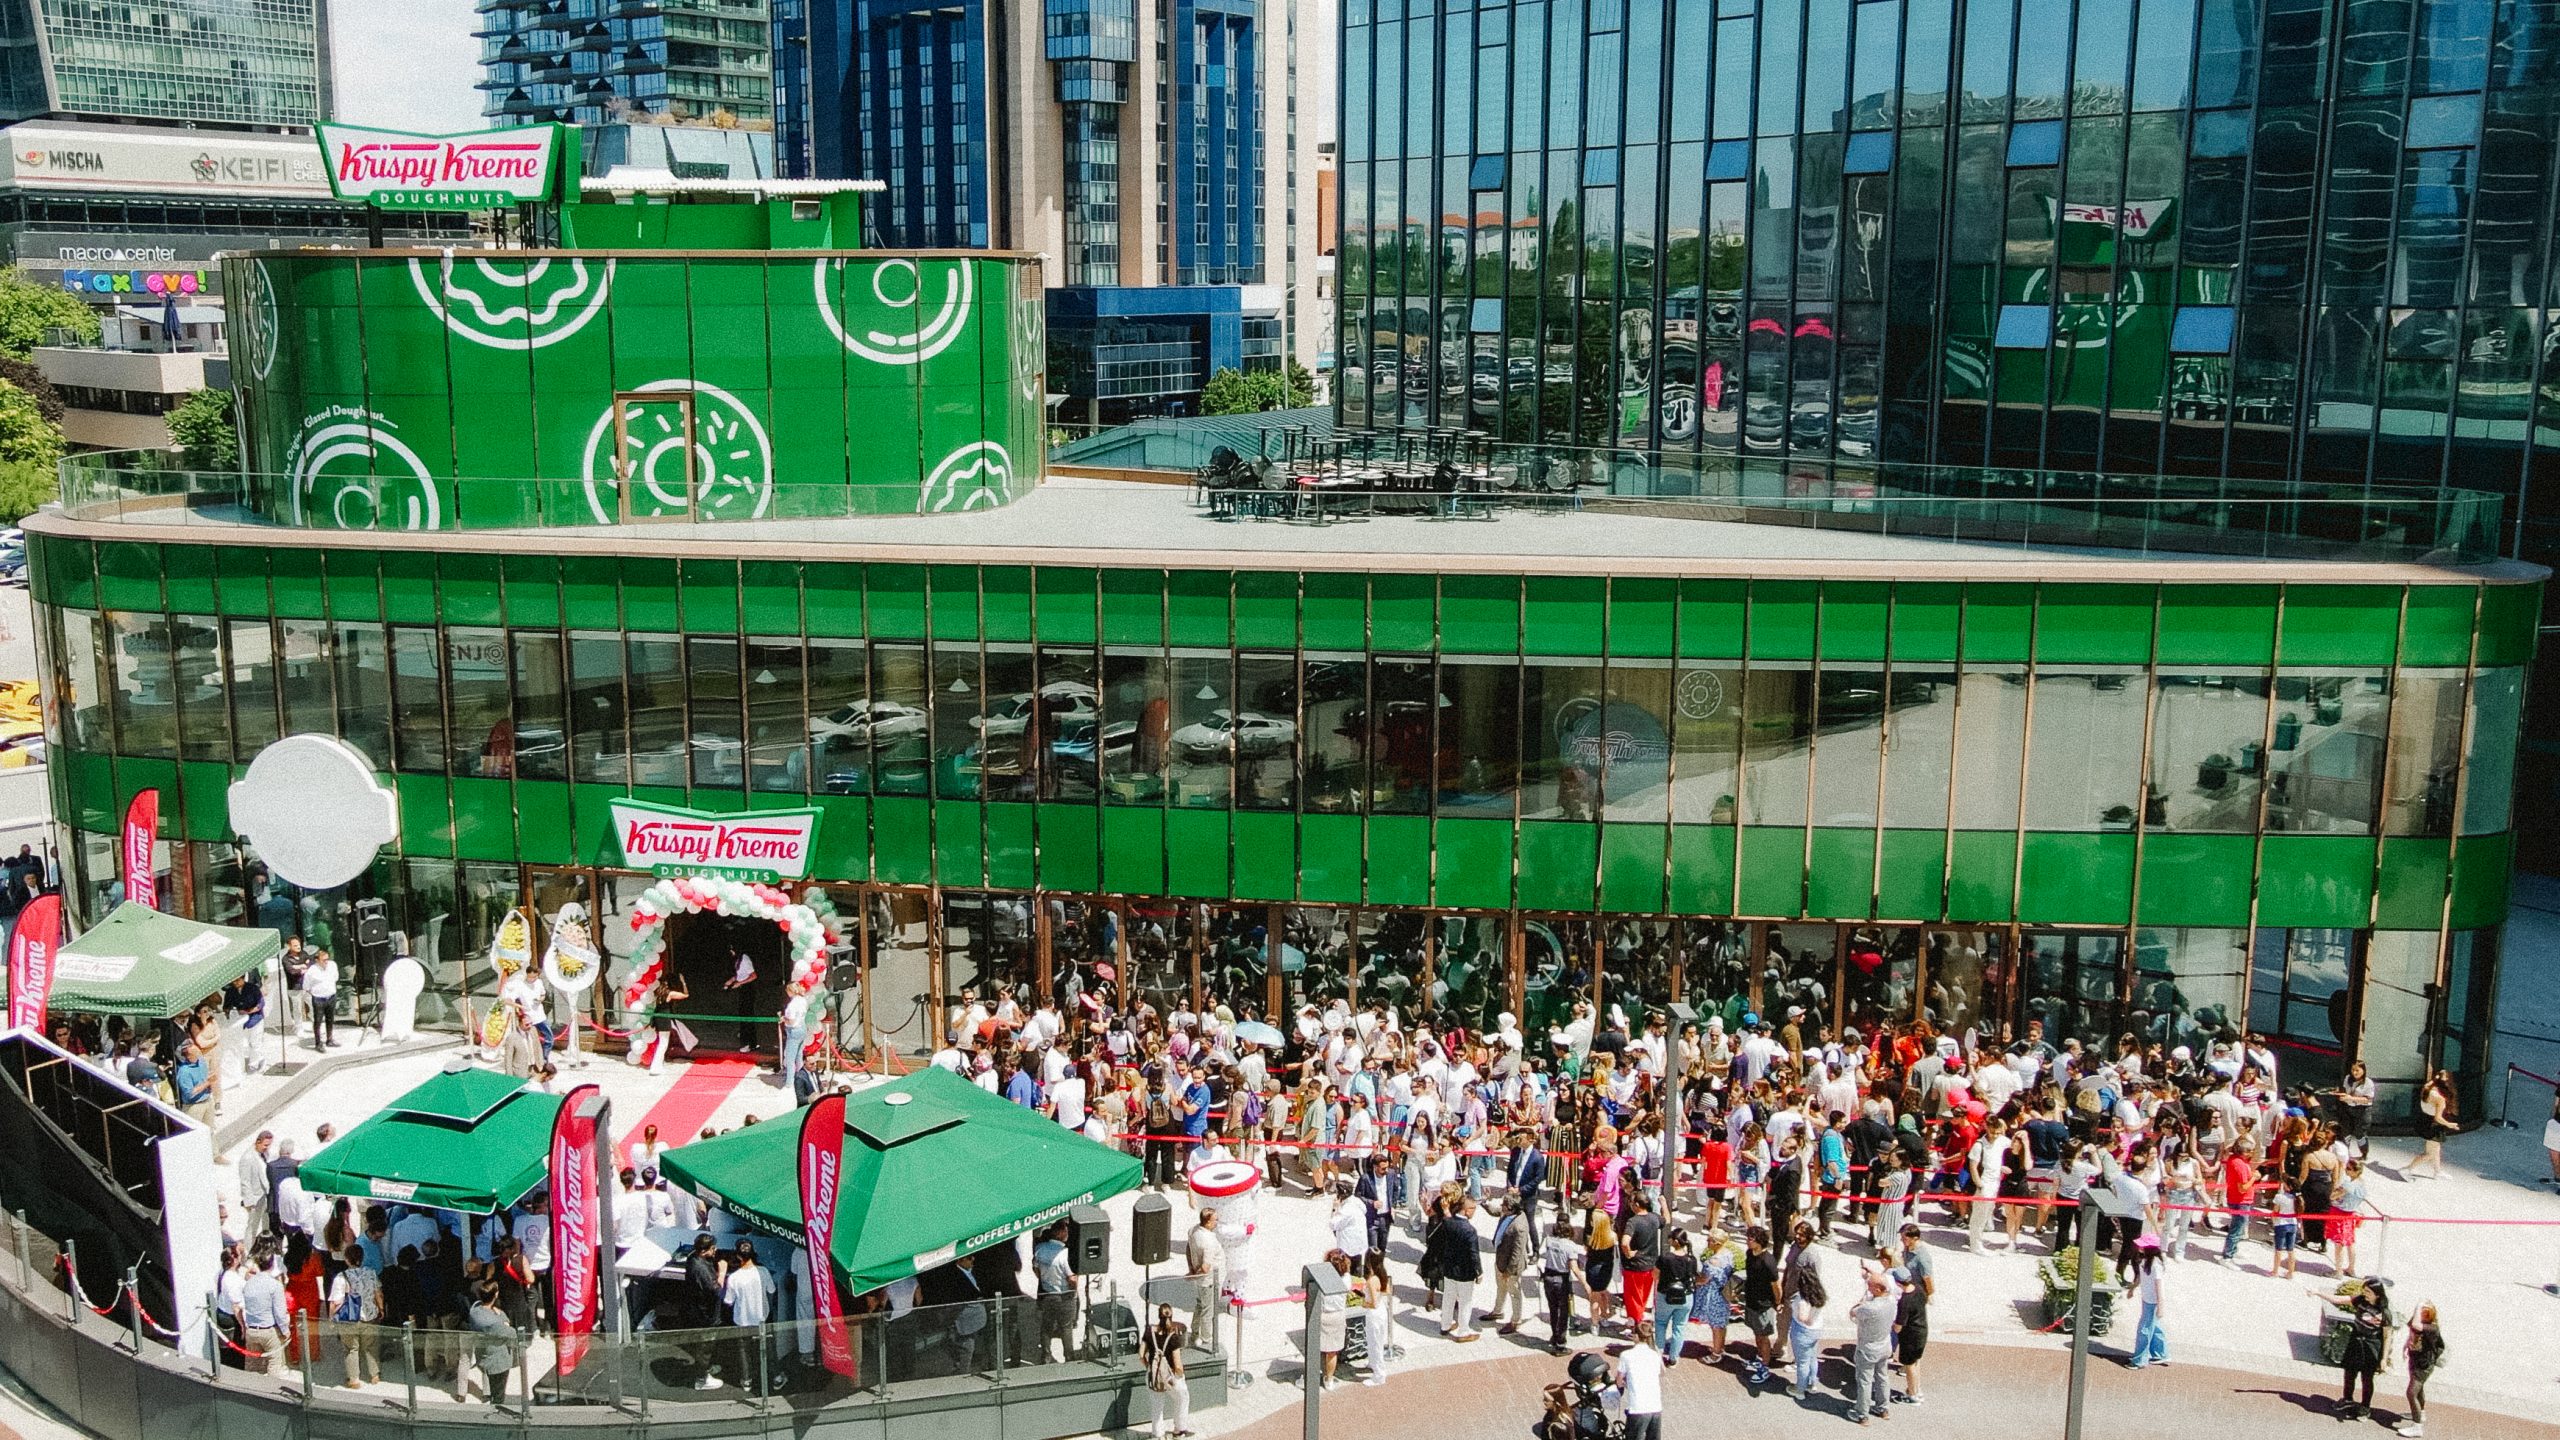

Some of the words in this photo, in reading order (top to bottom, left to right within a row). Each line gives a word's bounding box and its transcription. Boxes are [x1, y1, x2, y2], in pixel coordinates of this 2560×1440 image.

[49, 150, 104, 172] MISCHA
[221, 155, 288, 181] KEIFI
[293, 159, 312, 171] BIG
[339, 142, 440, 188] Krispy
[442, 142, 542, 182] Kreme
[380, 192, 505, 205] DOUGHNUTS
[63, 269, 207, 299] MaxLove!
[286, 423, 303, 461] Origin
[304, 407, 331, 428] Glazed
[129, 822, 150, 890] Kreme
[626, 820, 715, 863] Krispy
[714, 825, 803, 860] Kreme
[660, 866, 771, 882] DOUGHNUTS
[16, 933, 47, 1010] Kreme
[560, 1135, 583, 1239] Kreme
[807, 1143, 836, 1244] Kreme
[728, 1202, 762, 1226] COFFEE
[761, 1219, 770, 1230] &
[966, 1222, 1012, 1248] COFFEE
[1013, 1219, 1022, 1231] &
[1023, 1191, 1094, 1228] DOUGHNUTS
